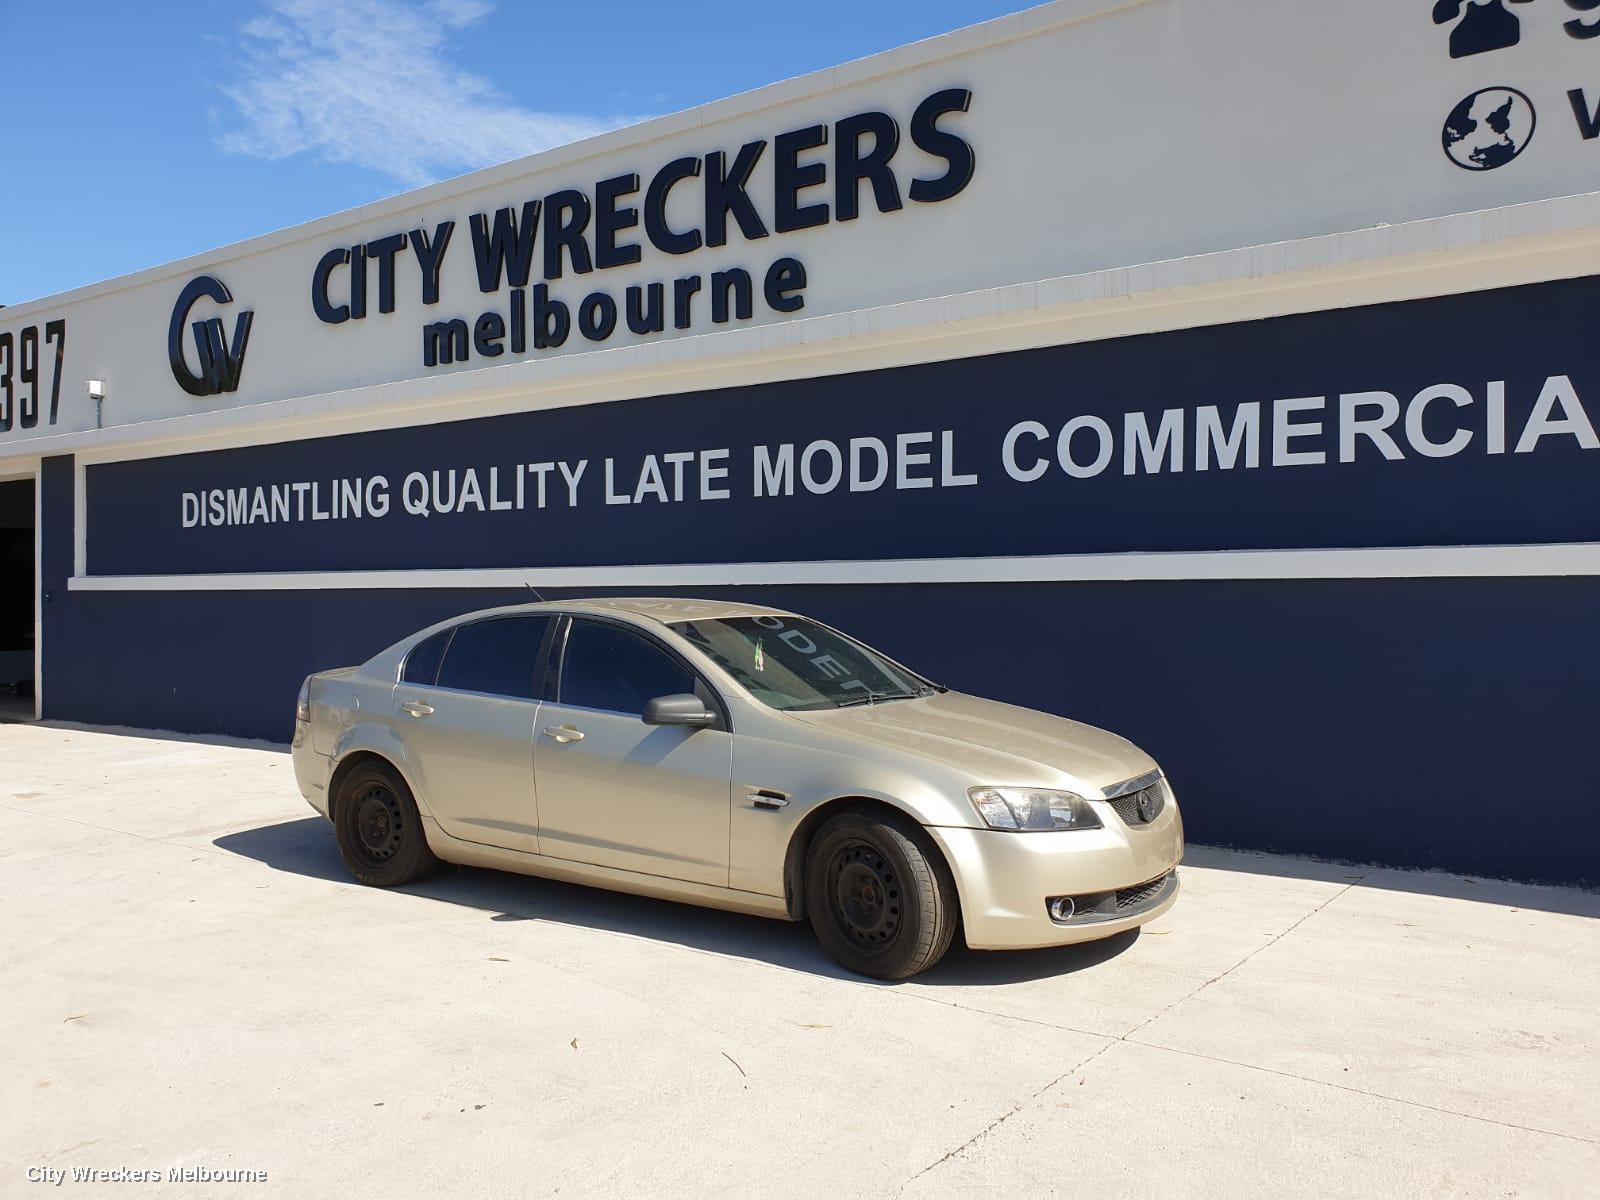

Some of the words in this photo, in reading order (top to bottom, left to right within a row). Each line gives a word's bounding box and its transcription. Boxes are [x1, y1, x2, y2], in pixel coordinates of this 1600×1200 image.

[311, 220, 455, 325] CITY
[468, 87, 976, 294] WRECKERS
[422, 256, 808, 368] melbourne
[182, 475, 390, 528] DISMANTLING
[402, 459, 588, 518] QUALITY
[605, 448, 731, 506] LATE
[753, 430, 978, 498] MODEL
[1002, 374, 1600, 482] COMMERCIA
